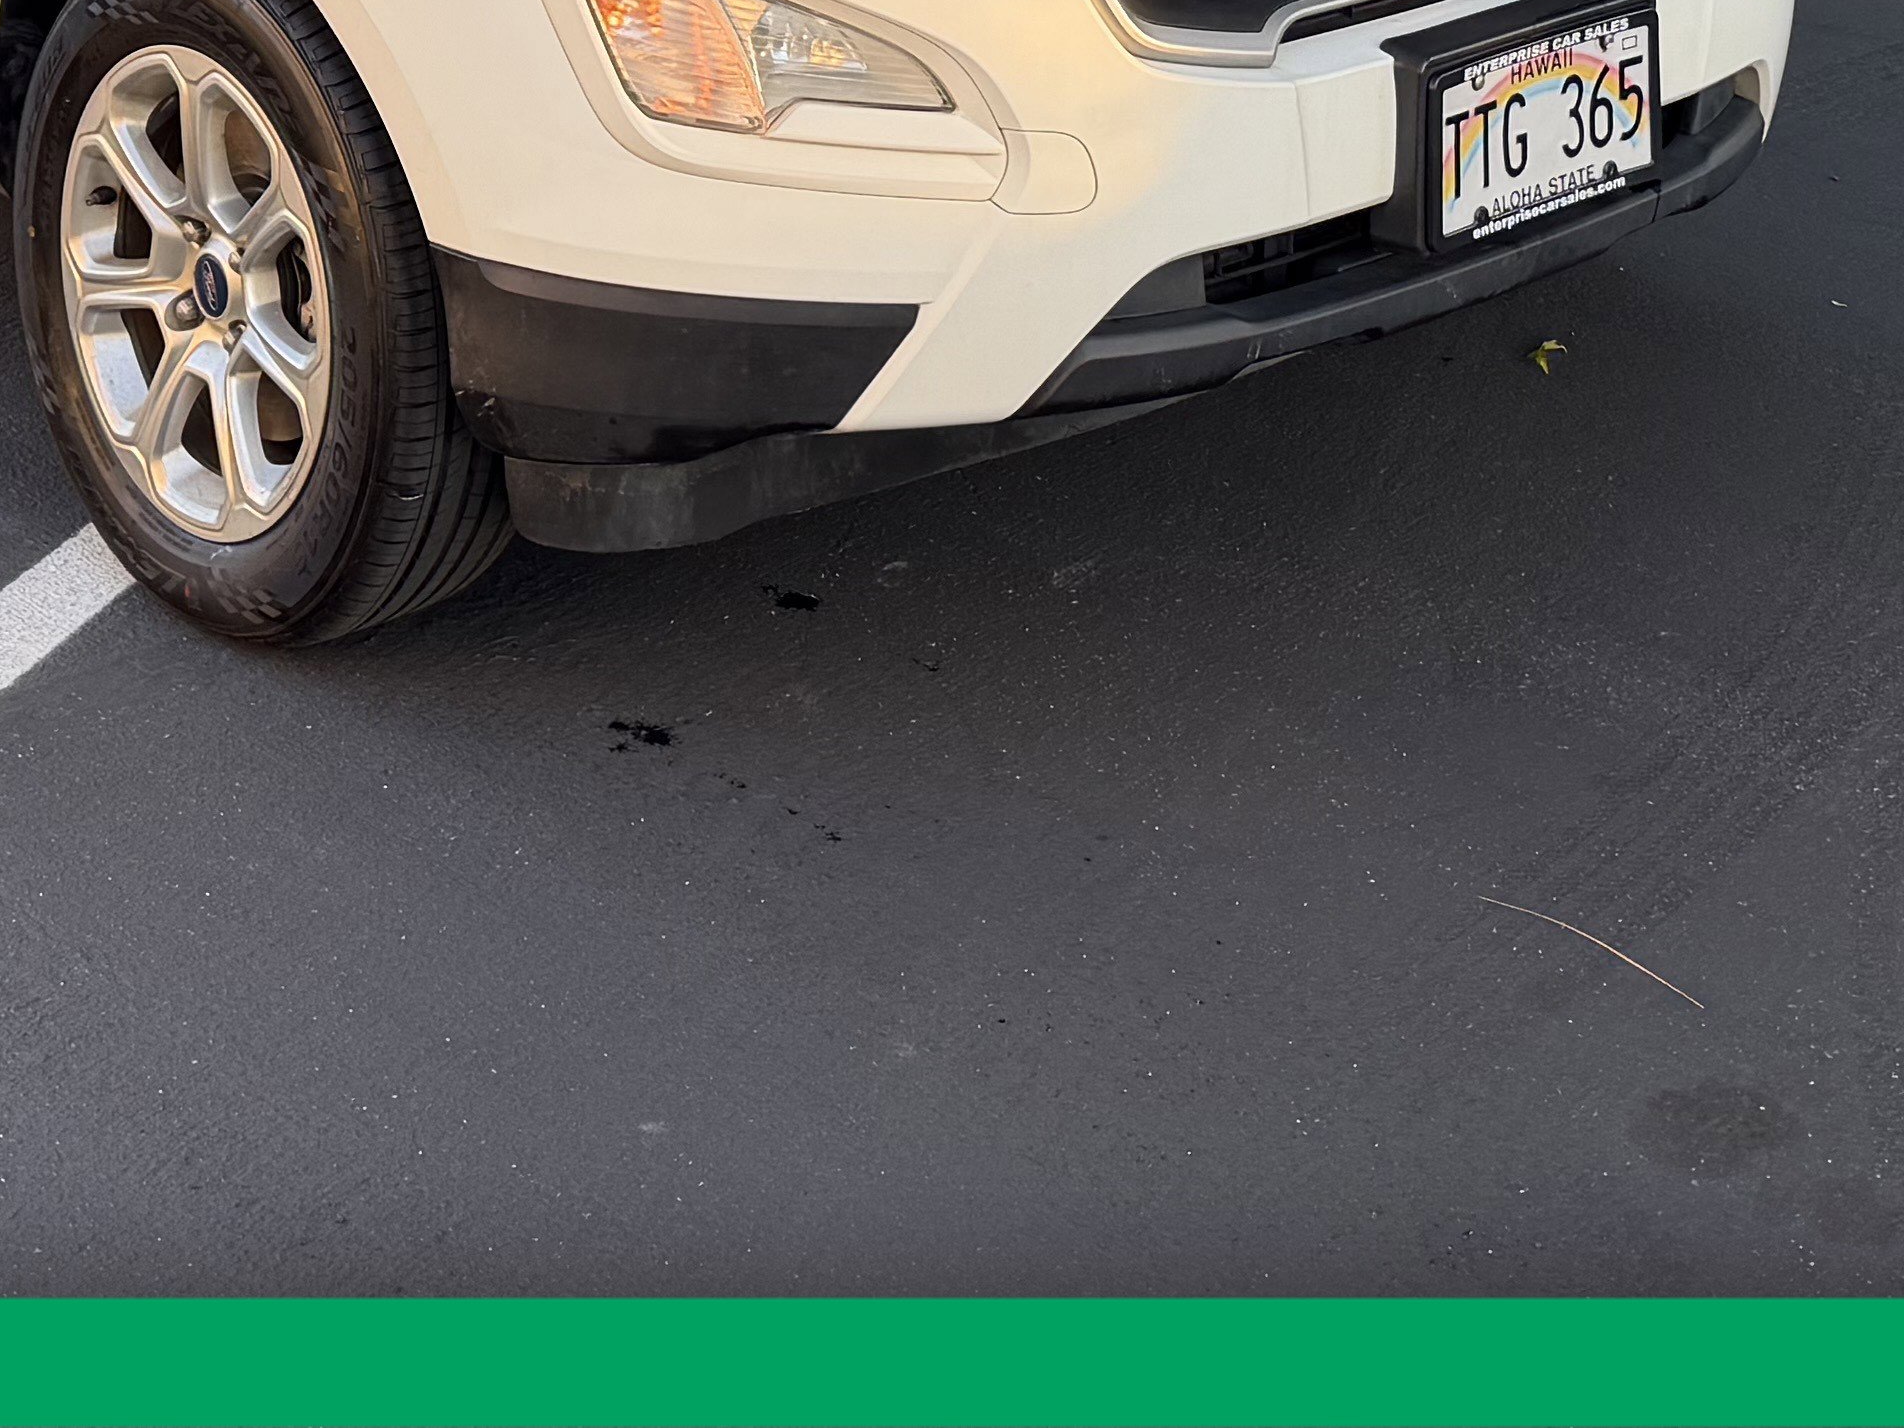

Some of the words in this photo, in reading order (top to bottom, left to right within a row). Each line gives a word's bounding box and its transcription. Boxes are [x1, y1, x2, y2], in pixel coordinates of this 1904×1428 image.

[1463, 41, 1550, 81] ENTERPRISE
[1552, 30, 1581, 51] CAR
[1584, 18, 1629, 40] SALES
[1510, 47, 1574, 84] HAWAII
[1445, 92, 1528, 200] TTG
[1560, 55, 1645, 158] 365
[1472, 175, 1626, 240] enterprisecarsales.com
[1492, 183, 1543, 214] ALOHA
[1548, 164, 1595, 195] STATE
